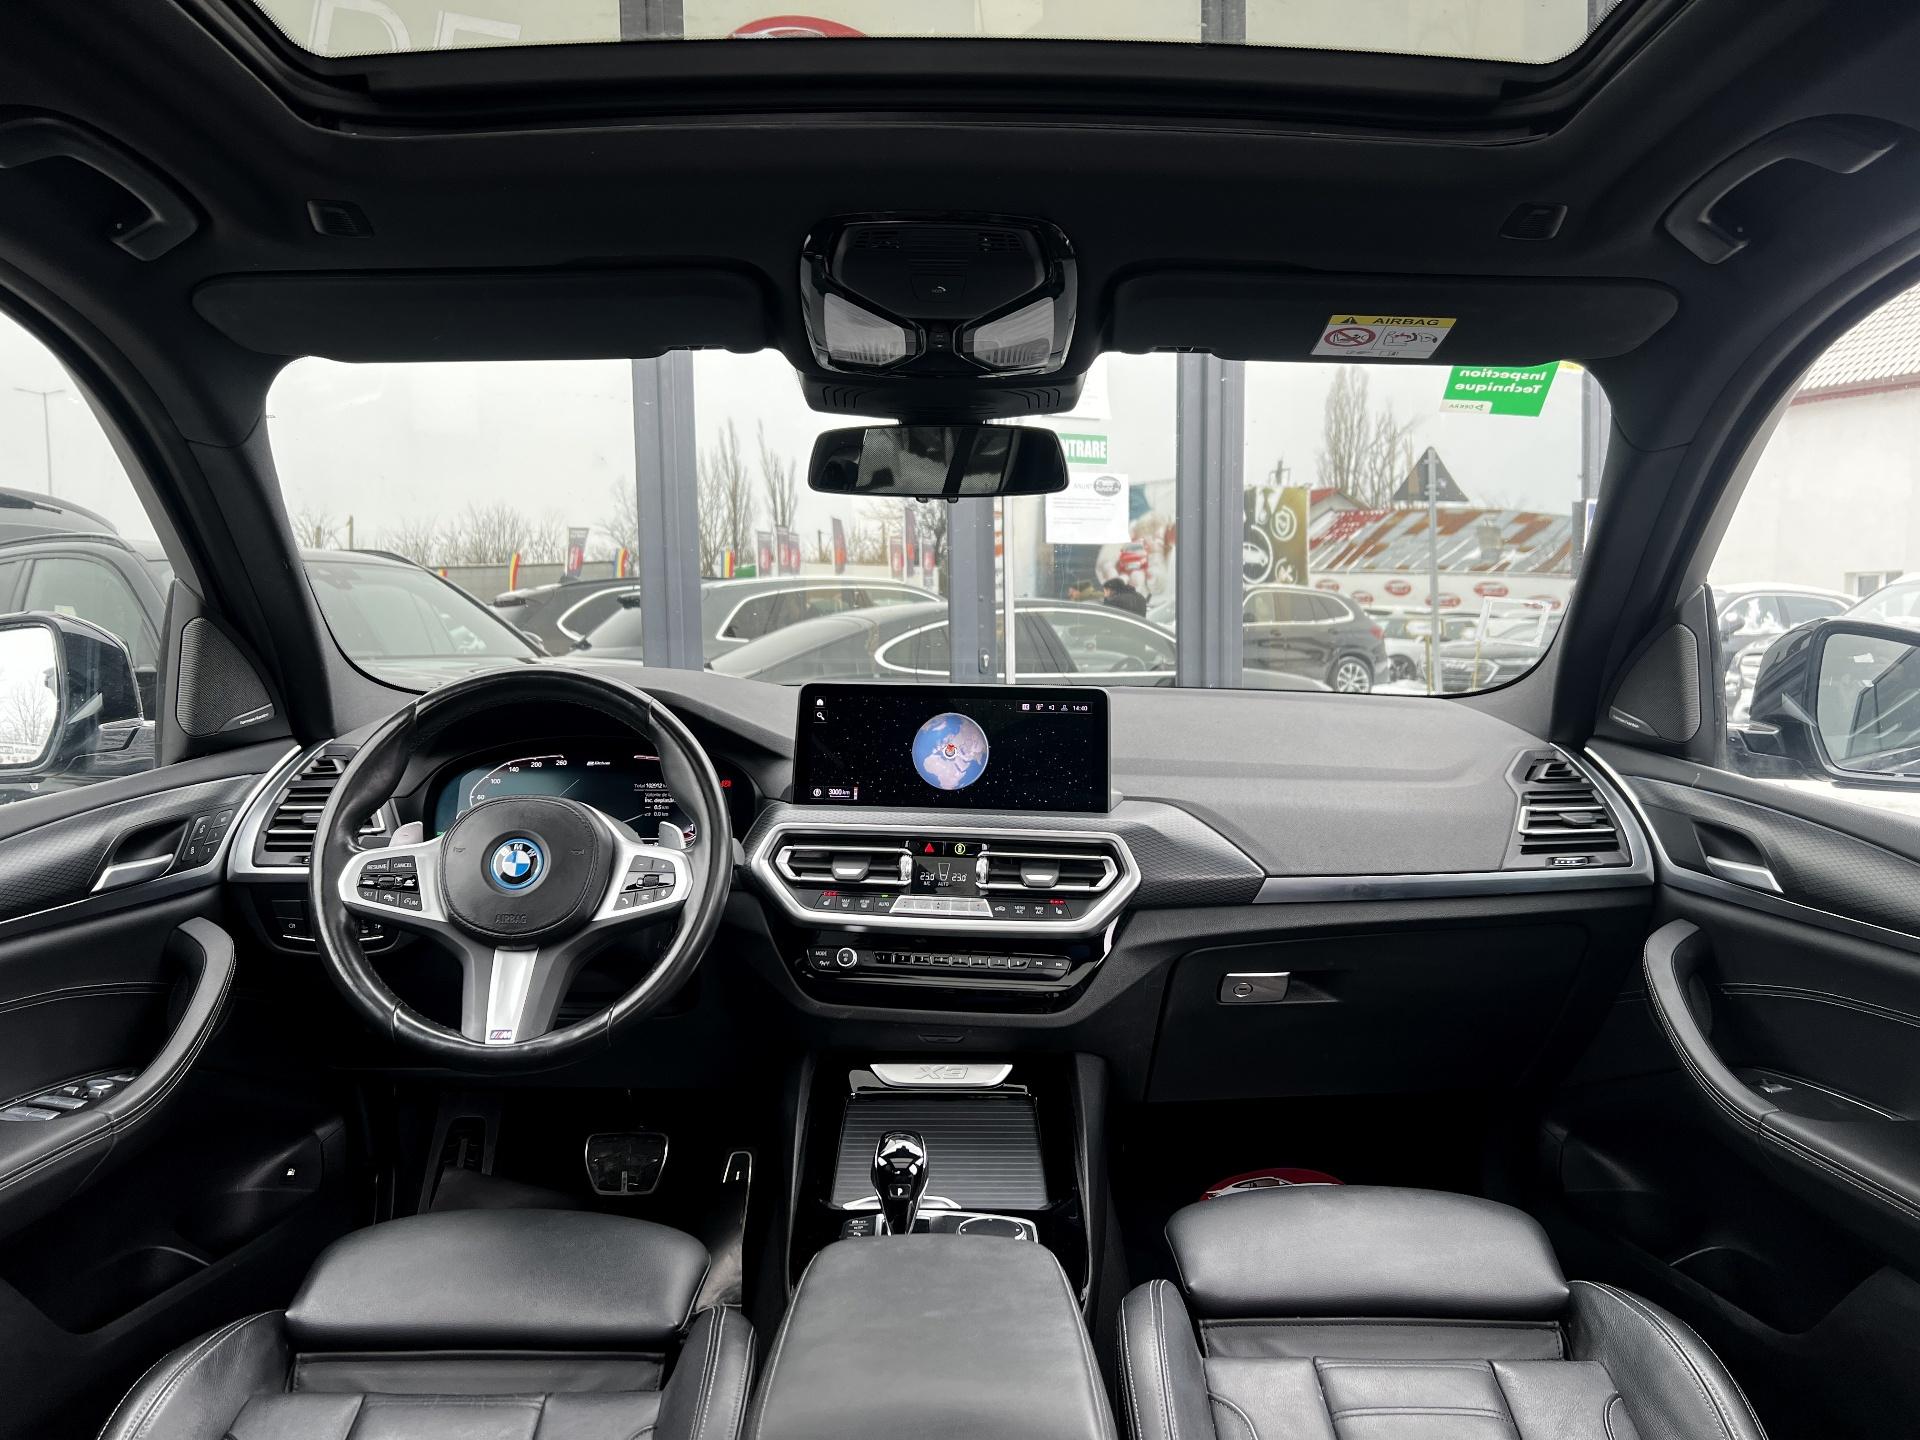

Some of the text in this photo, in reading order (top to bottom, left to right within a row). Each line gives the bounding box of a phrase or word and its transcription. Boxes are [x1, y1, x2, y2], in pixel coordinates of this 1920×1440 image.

[1372, 317, 1440, 326] AIRBAG
[1060, 438, 1107, 459] NTRARE
[500, 842, 537, 857] BMW
[495, 913, 527, 924] AIRBAG
[915, 1064, 969, 1080] X3
[897, 1187, 903, 1197] P
